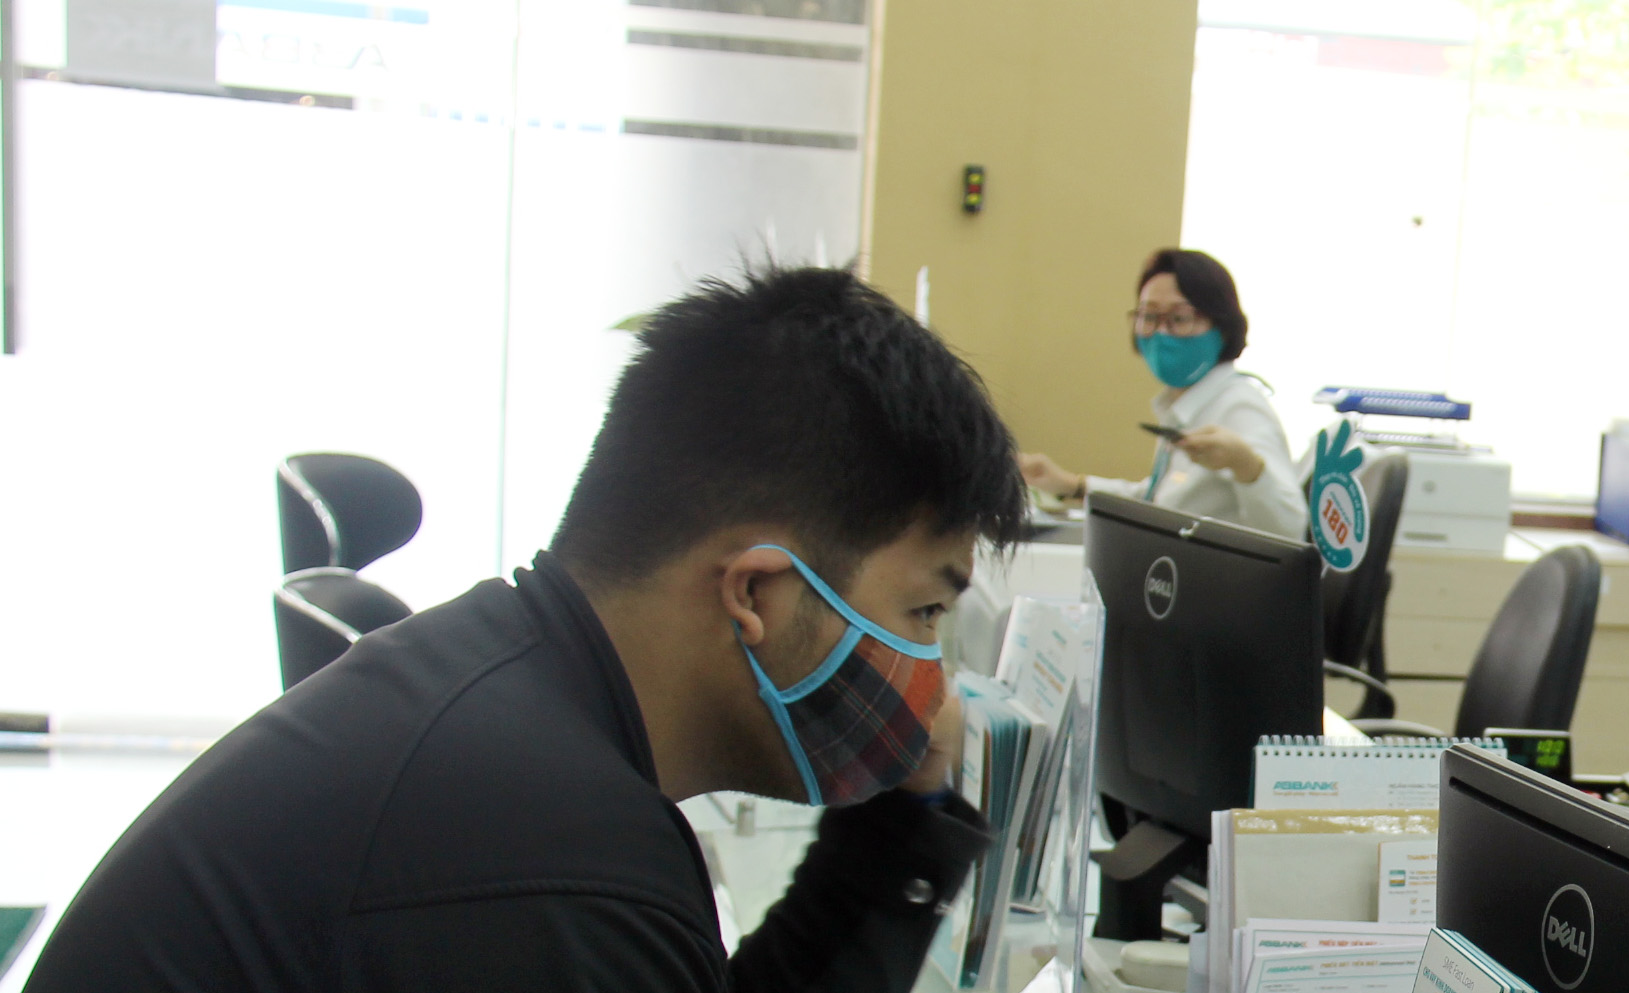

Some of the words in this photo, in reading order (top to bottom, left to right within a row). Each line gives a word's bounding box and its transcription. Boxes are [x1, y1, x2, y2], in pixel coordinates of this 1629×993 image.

[1322, 498, 1348, 544] 180
[1148, 577, 1171, 597] DELL
[1273, 780, 1338, 791] ABBANK
[1547, 915, 1587, 958] DELL
[1452, 963, 1464, 982] Fast
[1461, 971, 1475, 991] Loan
